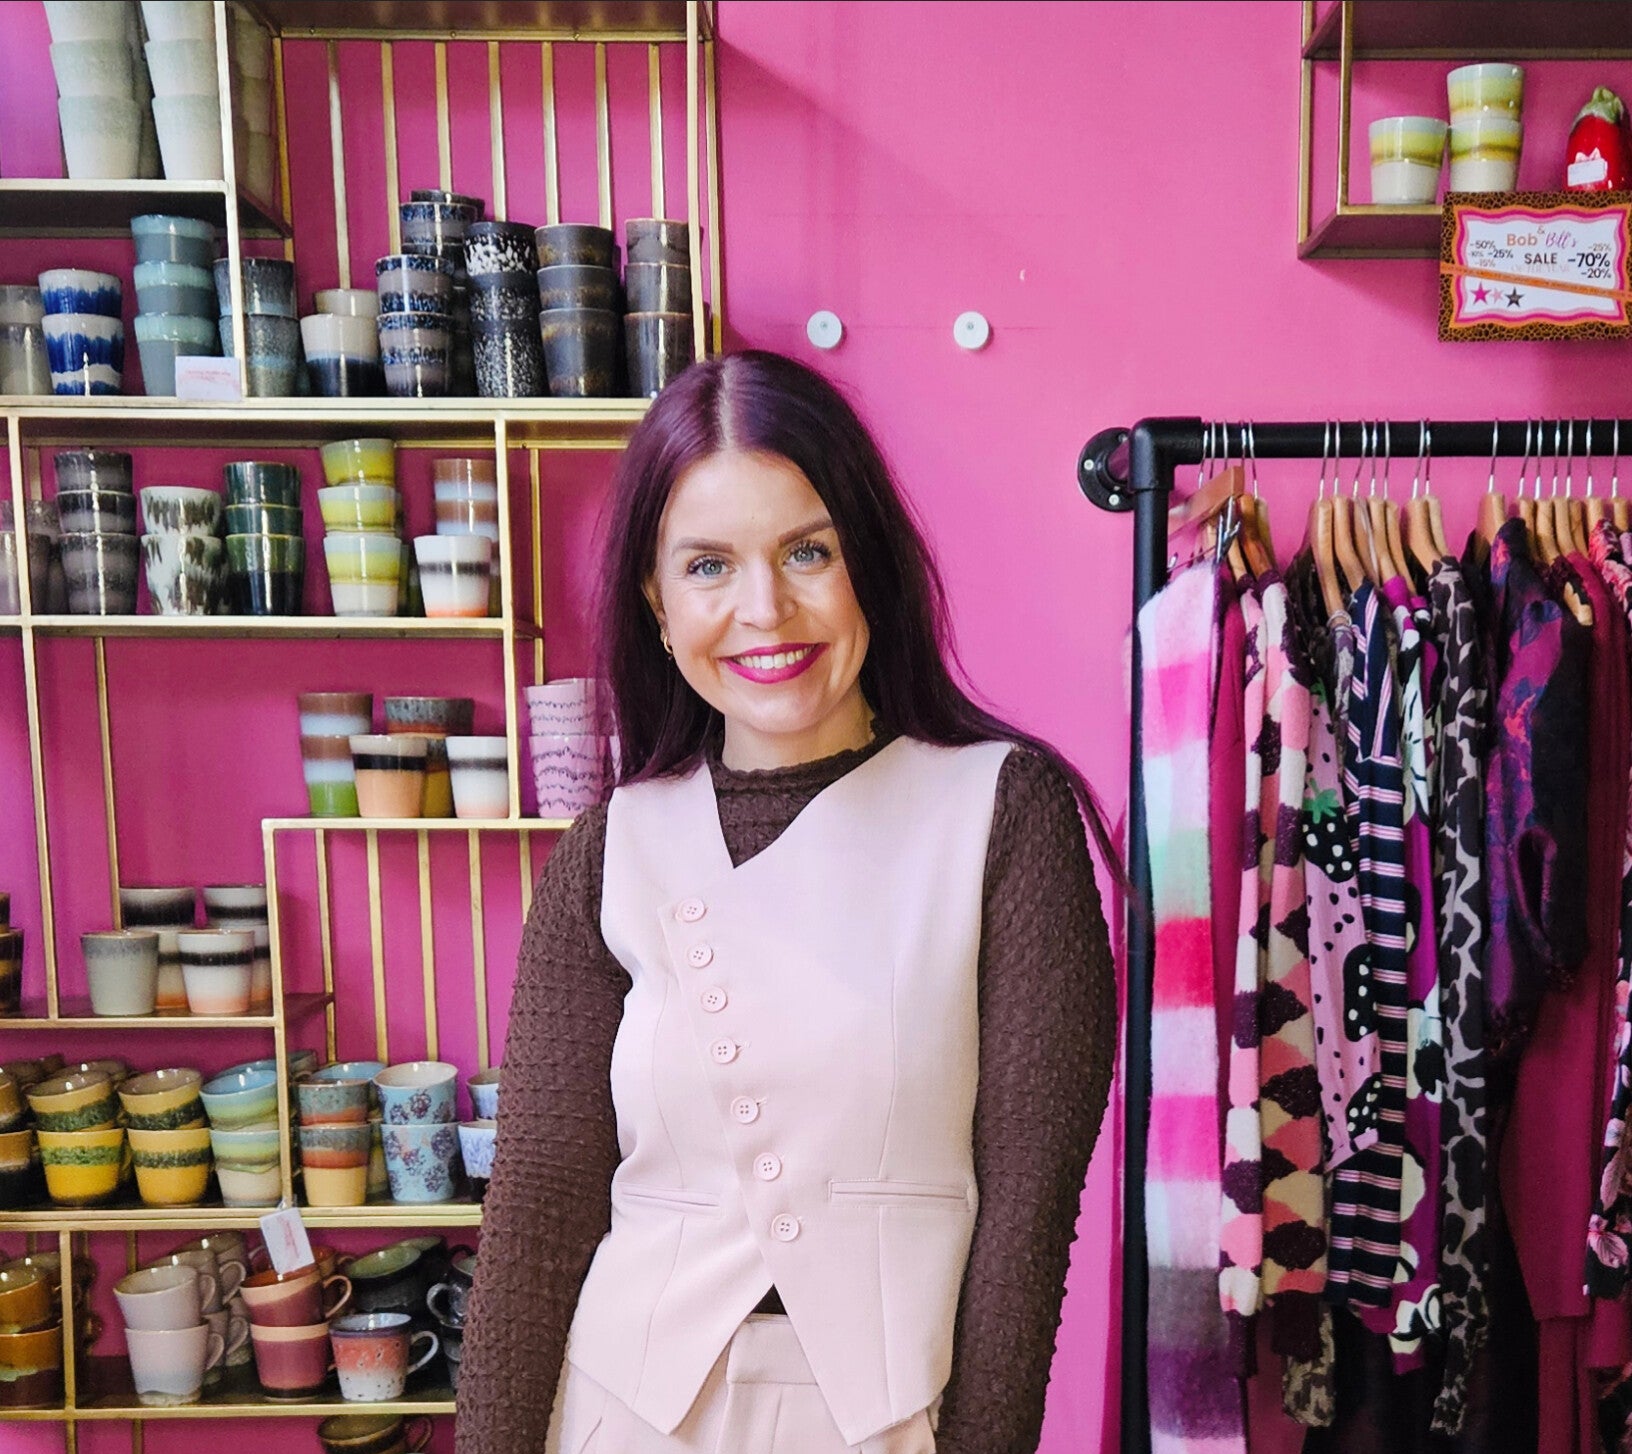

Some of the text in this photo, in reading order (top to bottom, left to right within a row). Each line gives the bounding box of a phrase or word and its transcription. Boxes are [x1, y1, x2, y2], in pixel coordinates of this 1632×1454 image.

[1470, 240, 1495, 250] -50%
[1507, 233, 1538, 246] Bob
[1488, 249, 1513, 259] -25%
[1524, 252, 1557, 265] SALE
[1568, 252, 1611, 267] -70%
[1581, 267, 1612, 279] -20%
